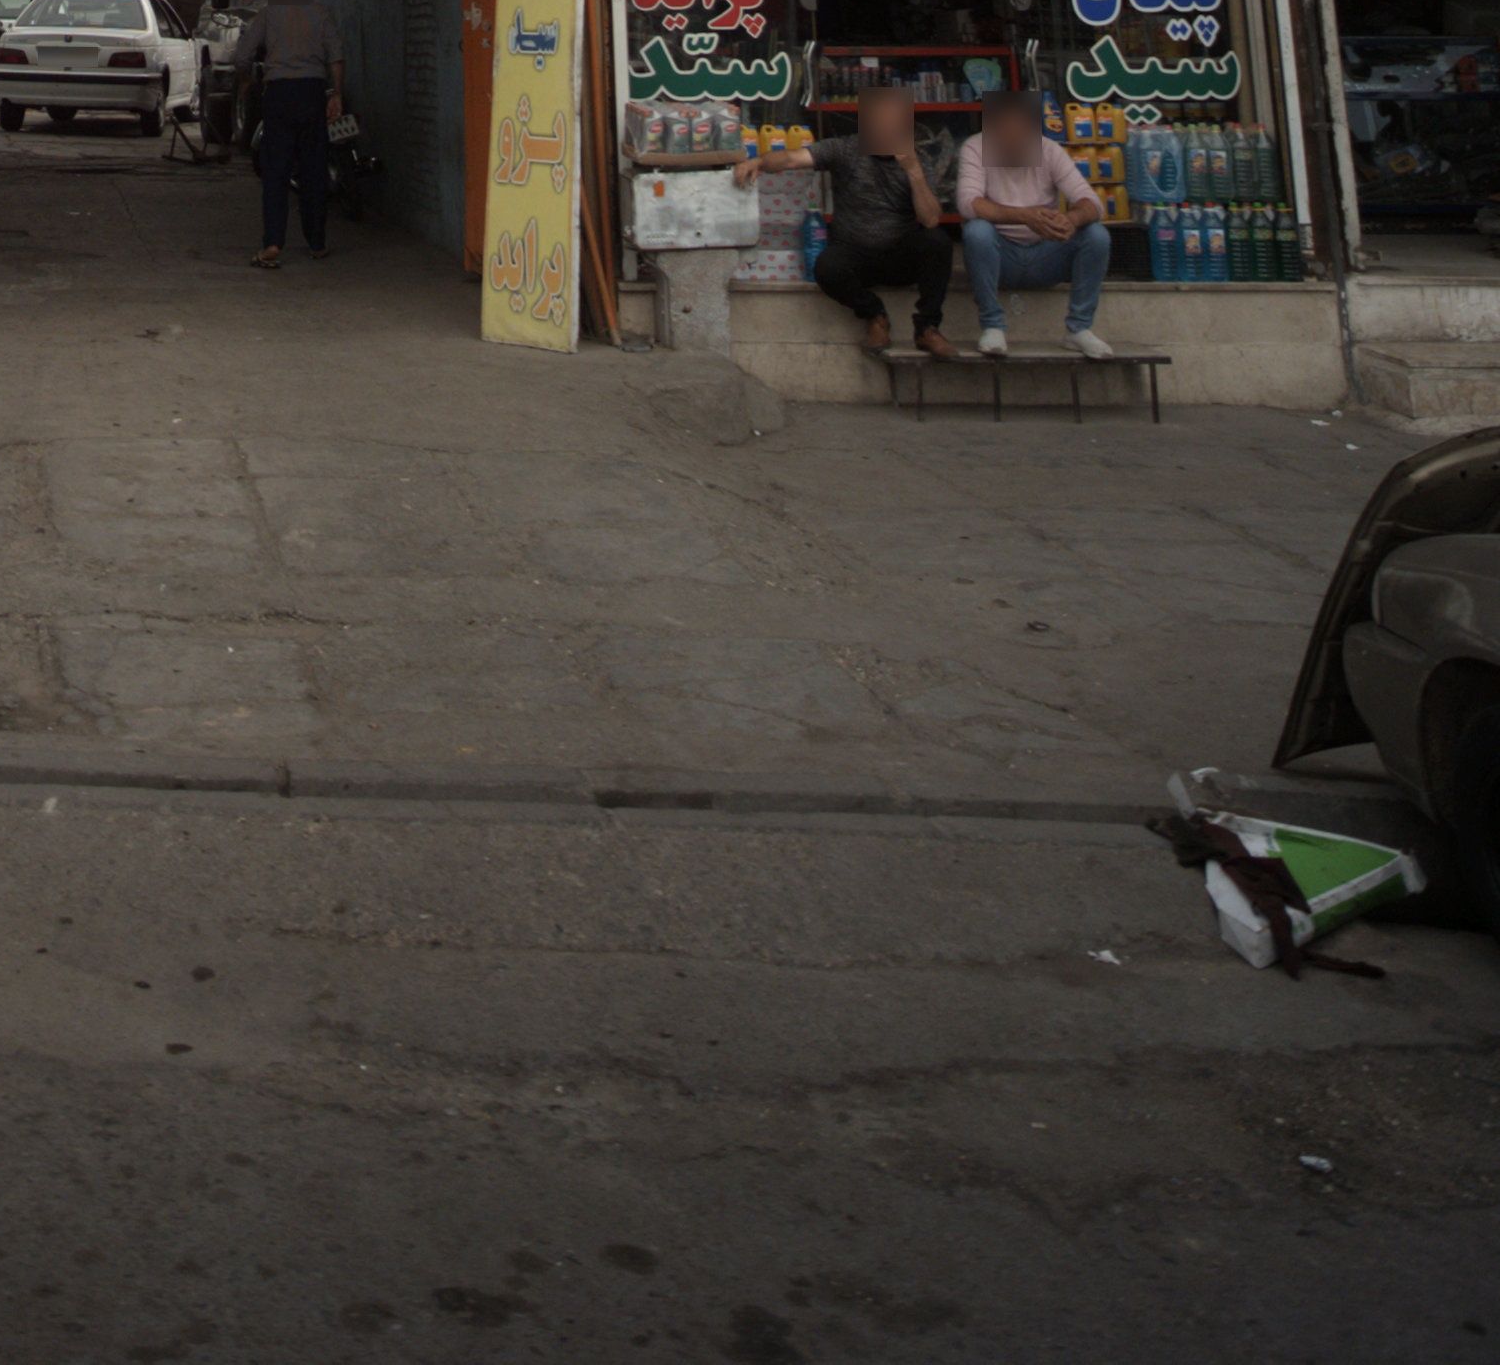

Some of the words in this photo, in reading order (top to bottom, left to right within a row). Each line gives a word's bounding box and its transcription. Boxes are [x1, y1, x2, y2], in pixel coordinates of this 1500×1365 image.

[508, 7, 560, 72] سید
[1065, 34, 1242, 127] سید
[494, 94, 567, 194] پژو
[490, 217, 567, 327] پراید
